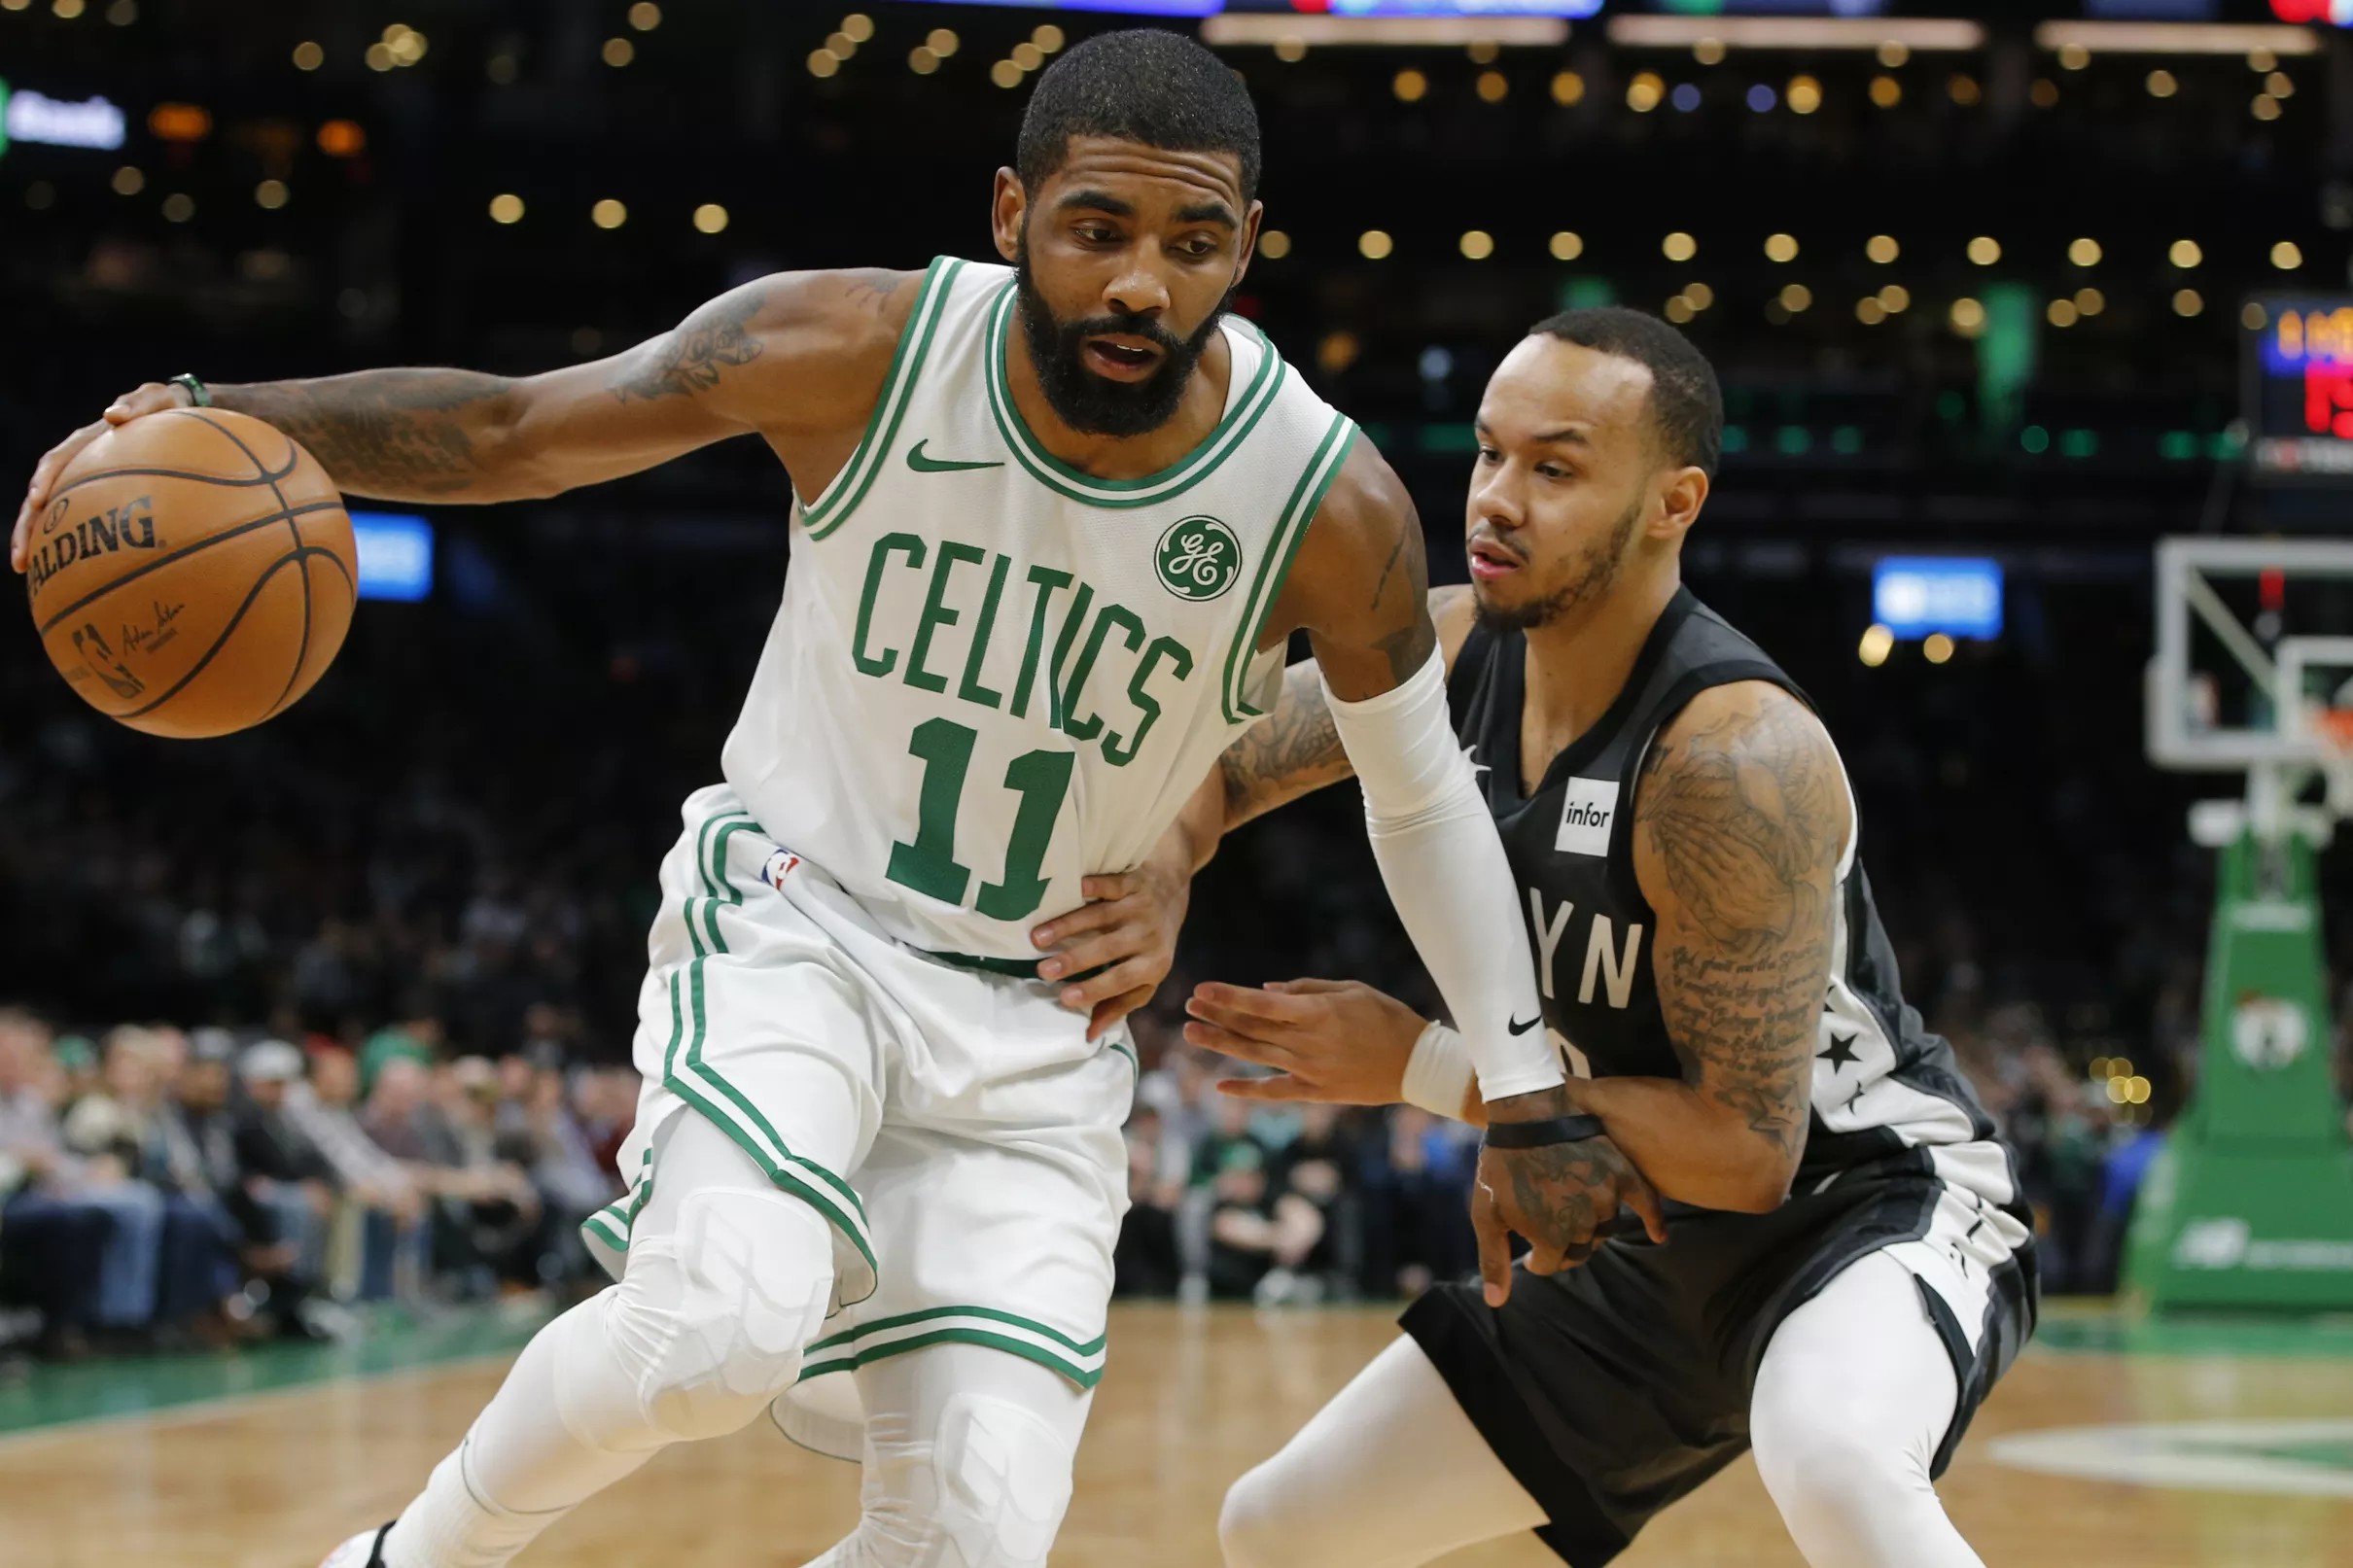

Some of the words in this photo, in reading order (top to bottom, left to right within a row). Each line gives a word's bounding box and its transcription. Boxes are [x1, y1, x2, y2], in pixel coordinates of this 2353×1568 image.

[31, 495, 156, 596] ALDING
[1169, 533, 1225, 586] GE
[852, 532, 1194, 768] CELTICS
[885, 716, 1075, 922] 11
[1566, 801, 1610, 827] infor
